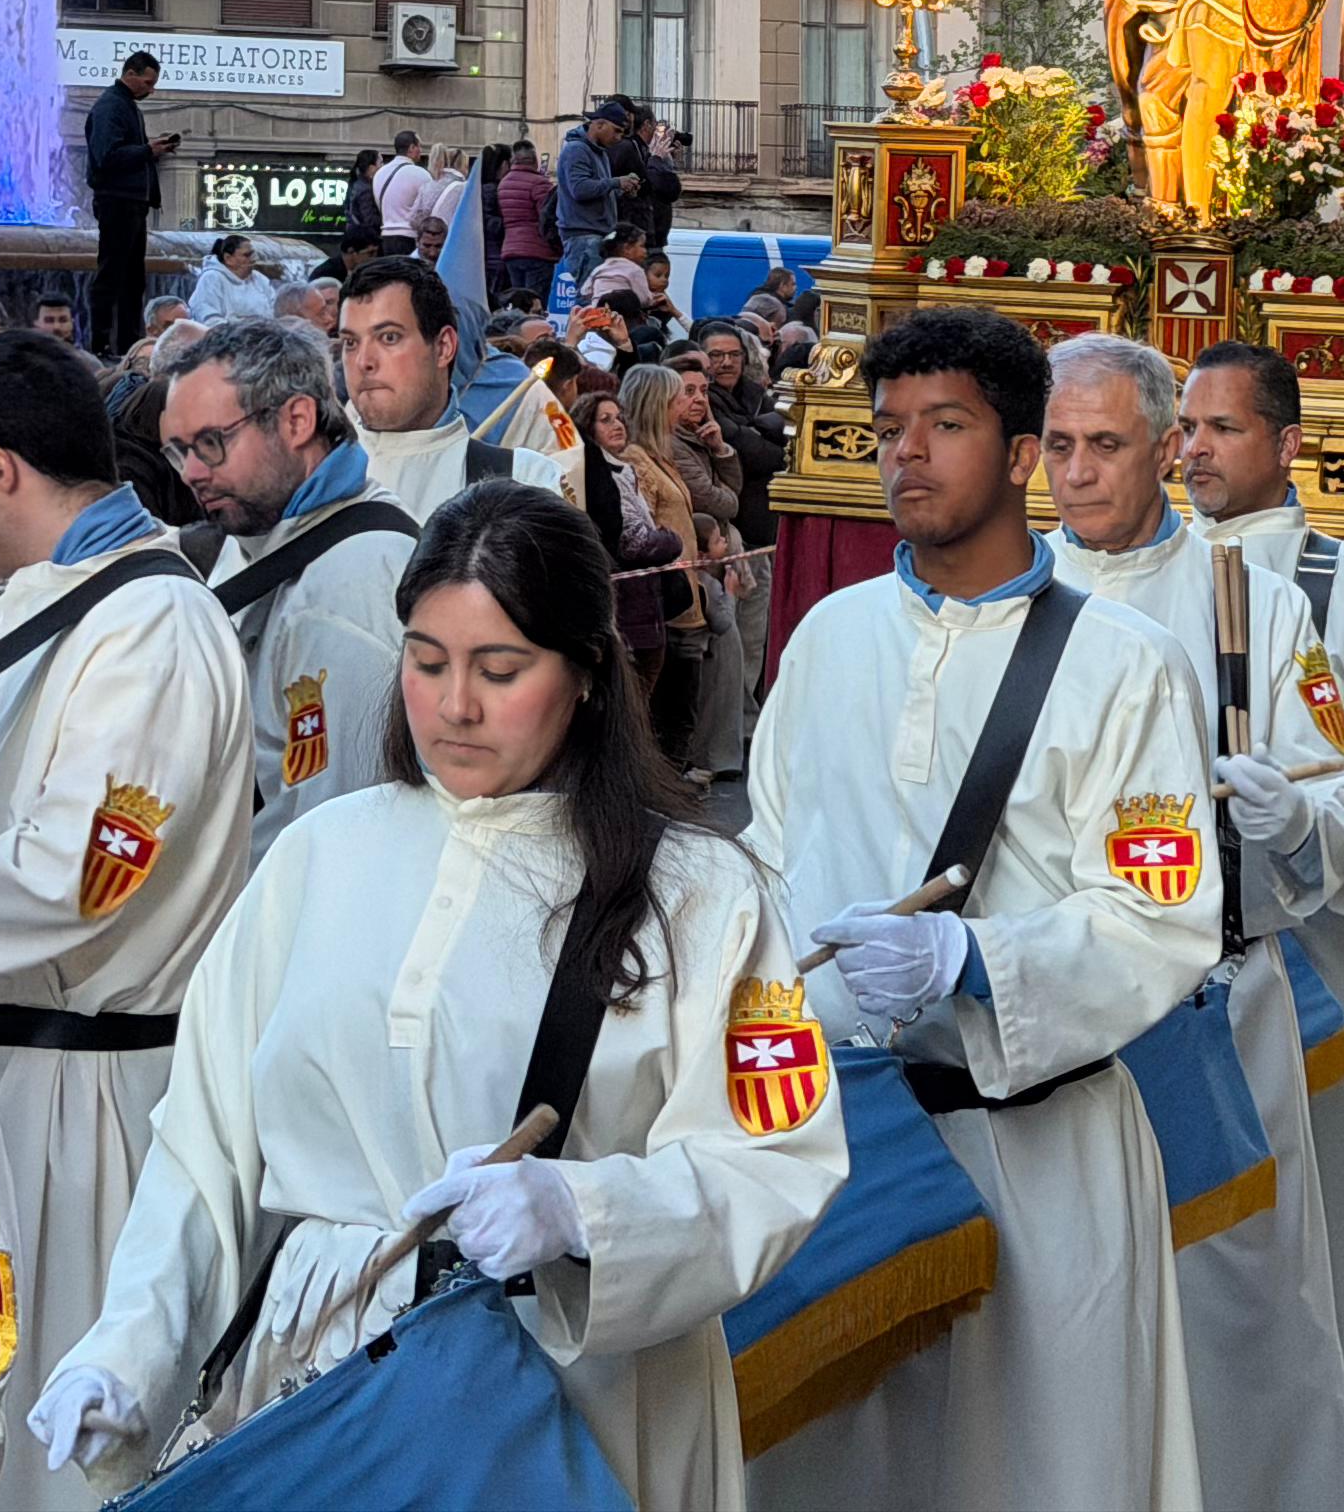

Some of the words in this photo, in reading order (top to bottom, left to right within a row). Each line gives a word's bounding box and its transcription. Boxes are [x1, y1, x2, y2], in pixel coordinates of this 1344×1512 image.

[216, 45, 328, 71] LATORRE
[175, 69, 305, 86] D'ASSEGURANCES
[270, 177, 307, 207] LO
